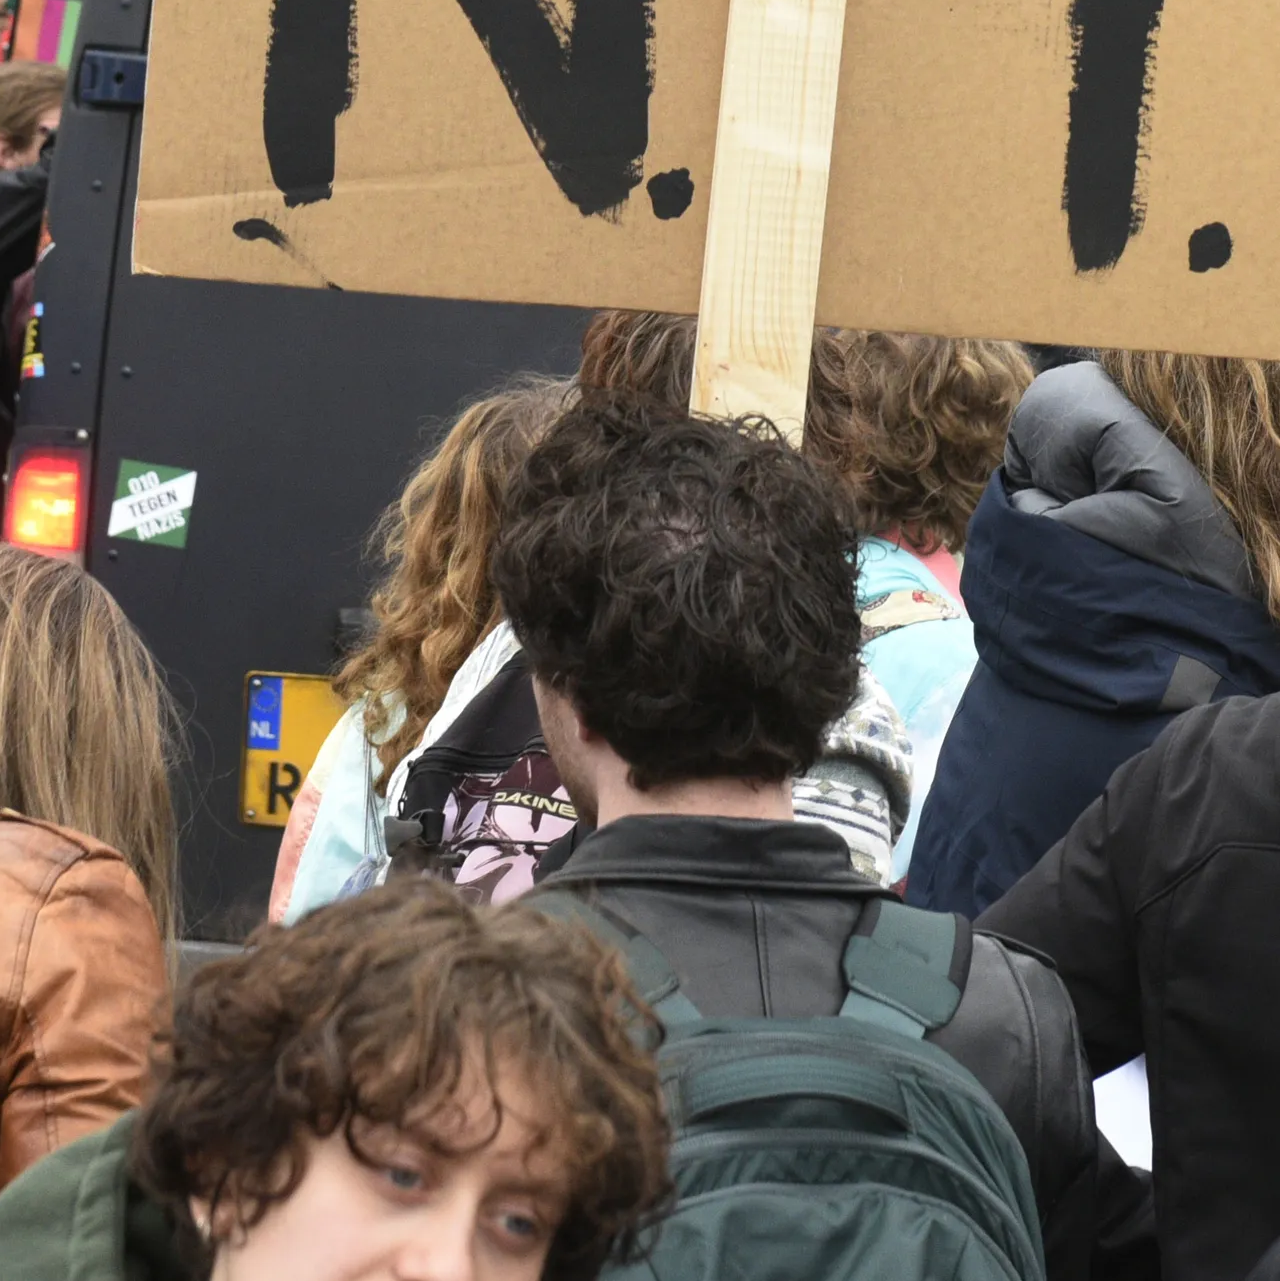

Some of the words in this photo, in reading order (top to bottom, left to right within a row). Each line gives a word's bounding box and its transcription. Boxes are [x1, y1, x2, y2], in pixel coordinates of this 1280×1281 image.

[127, 471, 160, 495] 010
[128, 489, 178, 519] TEGEN
[136, 509, 186, 541] NAZIS
[249, 721, 276, 739] NL
[493, 790, 579, 819] DAKINE
